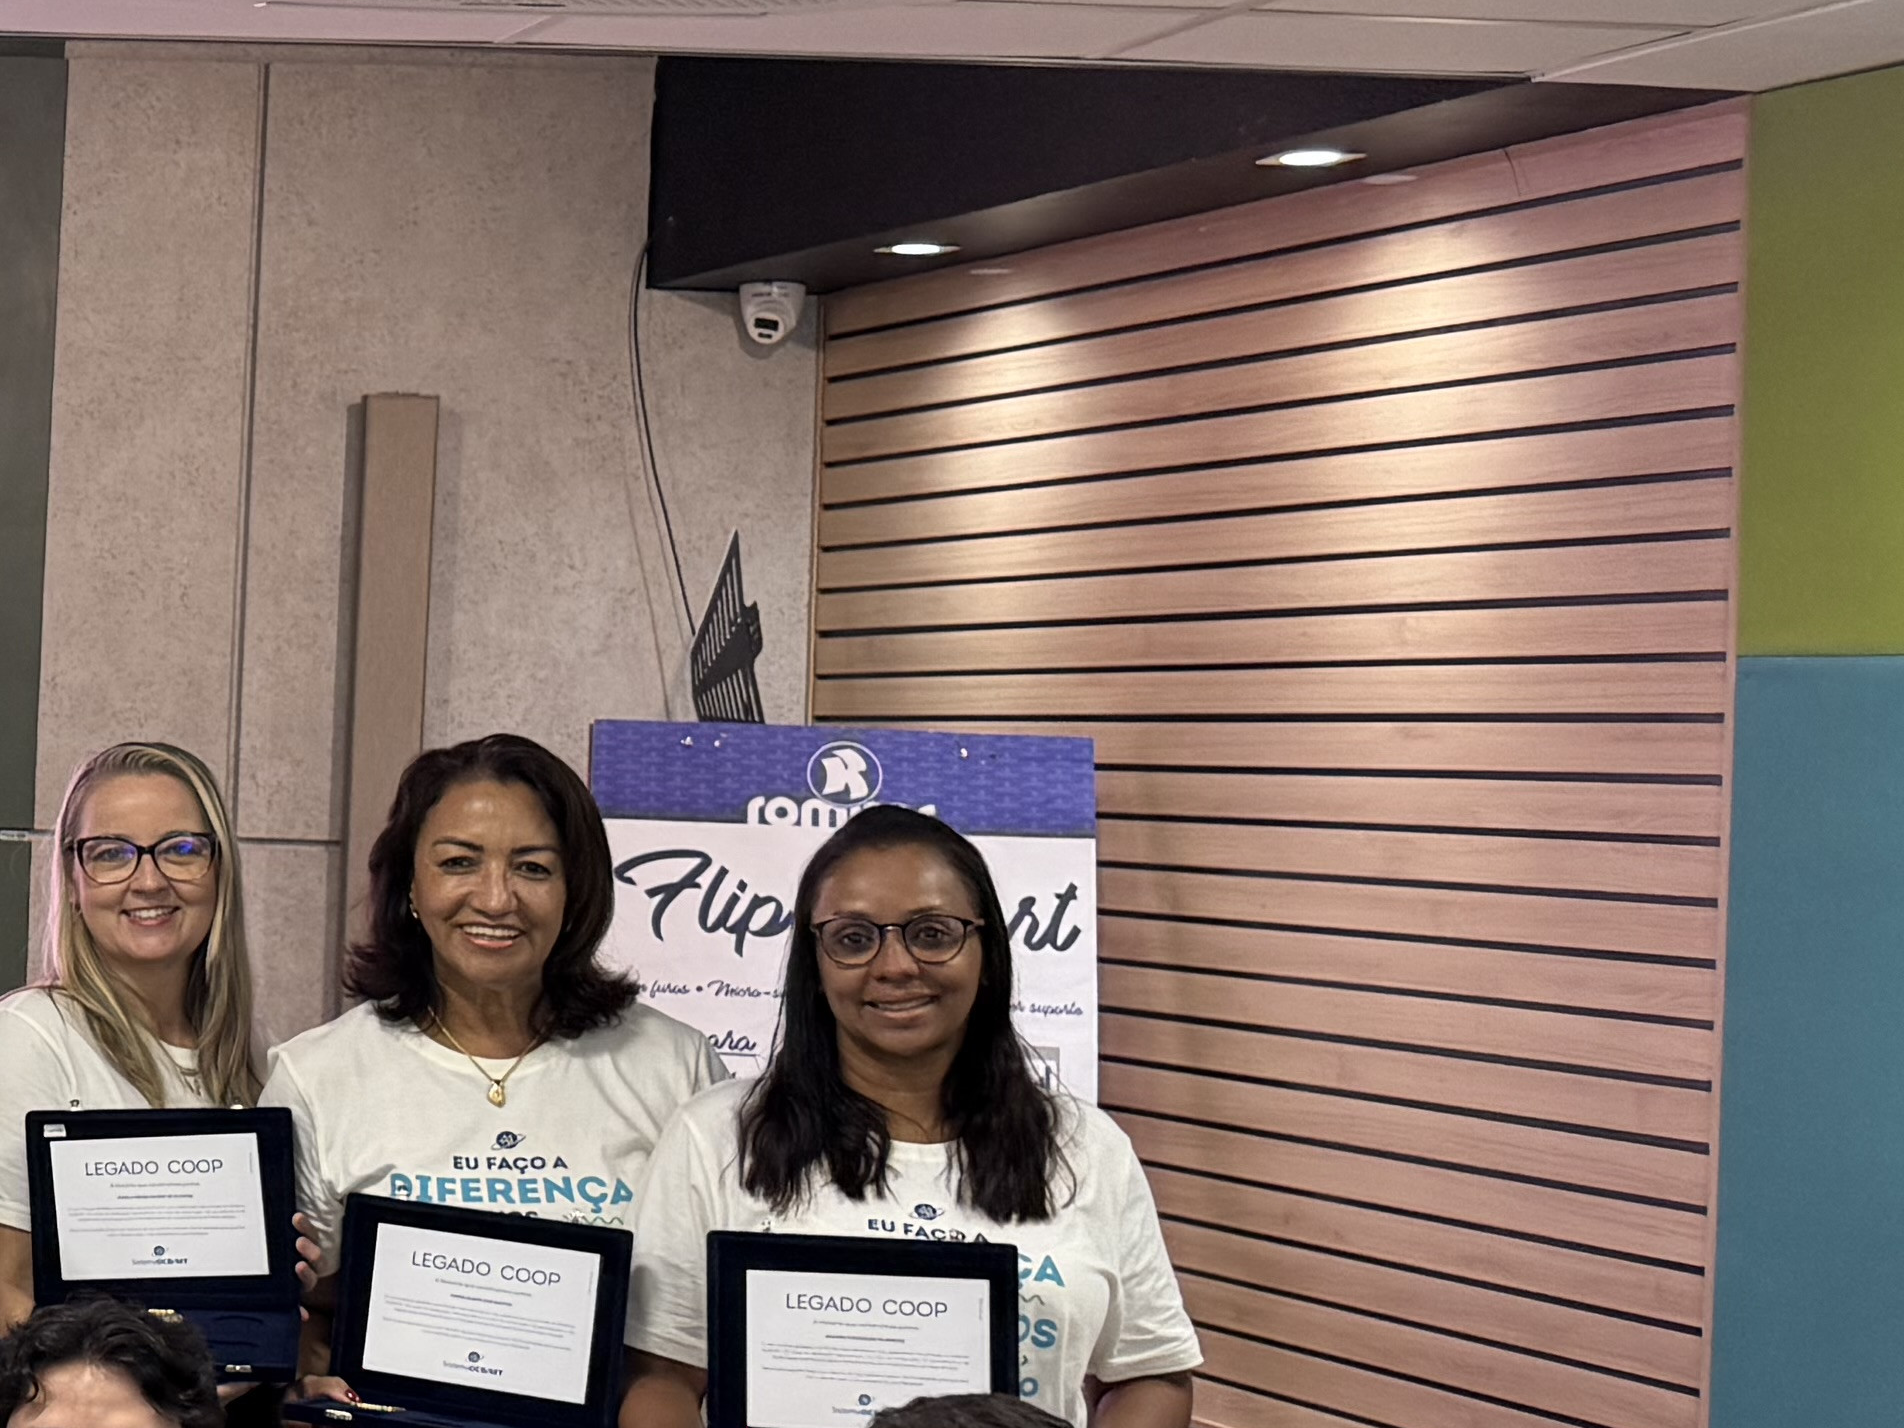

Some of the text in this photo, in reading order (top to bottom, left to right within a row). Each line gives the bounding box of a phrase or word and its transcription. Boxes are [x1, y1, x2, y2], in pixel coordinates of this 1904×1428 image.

[85, 1159, 223, 1176] LEGADO COOP
[453, 1155, 568, 1175] EU FAÇO A
[390, 1172, 634, 1214] DIFERENÇA
[867, 1218, 896, 1232] EU
[412, 1251, 560, 1286] LEGADO COOP
[787, 1293, 947, 1317] LEGADO COOP
